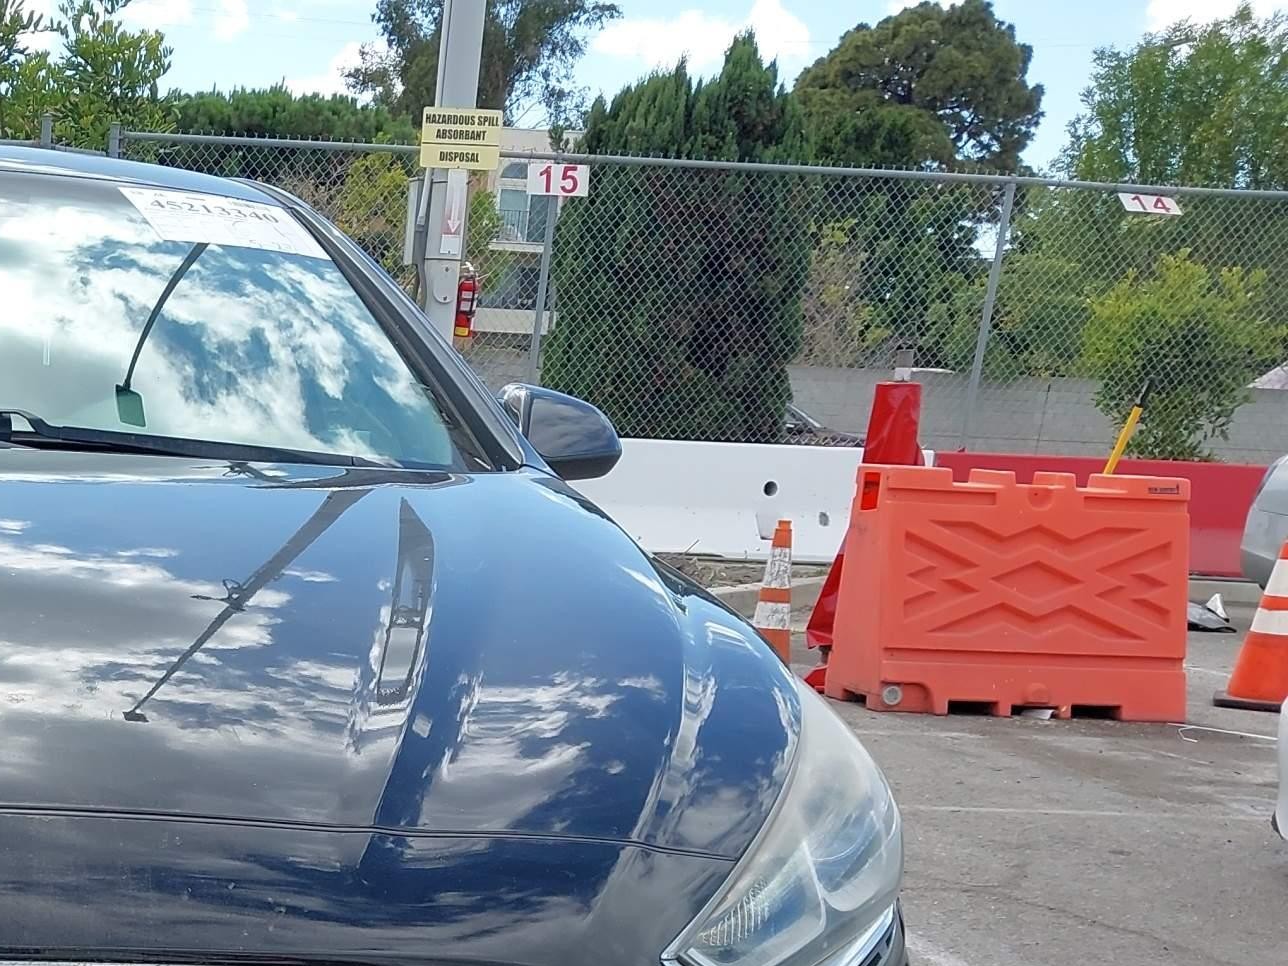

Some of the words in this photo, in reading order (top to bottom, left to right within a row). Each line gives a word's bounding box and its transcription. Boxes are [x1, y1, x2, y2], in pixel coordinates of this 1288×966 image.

[425, 113, 476, 126] HAZARDOUS
[477, 115, 500, 127] SPILL
[435, 128, 487, 141] ABSORBANT
[439, 151, 480, 163] DISPOSAL
[539, 165, 579, 194] 15
[150, 198, 279, 224] 45213340
[1131, 195, 1171, 213] 14
